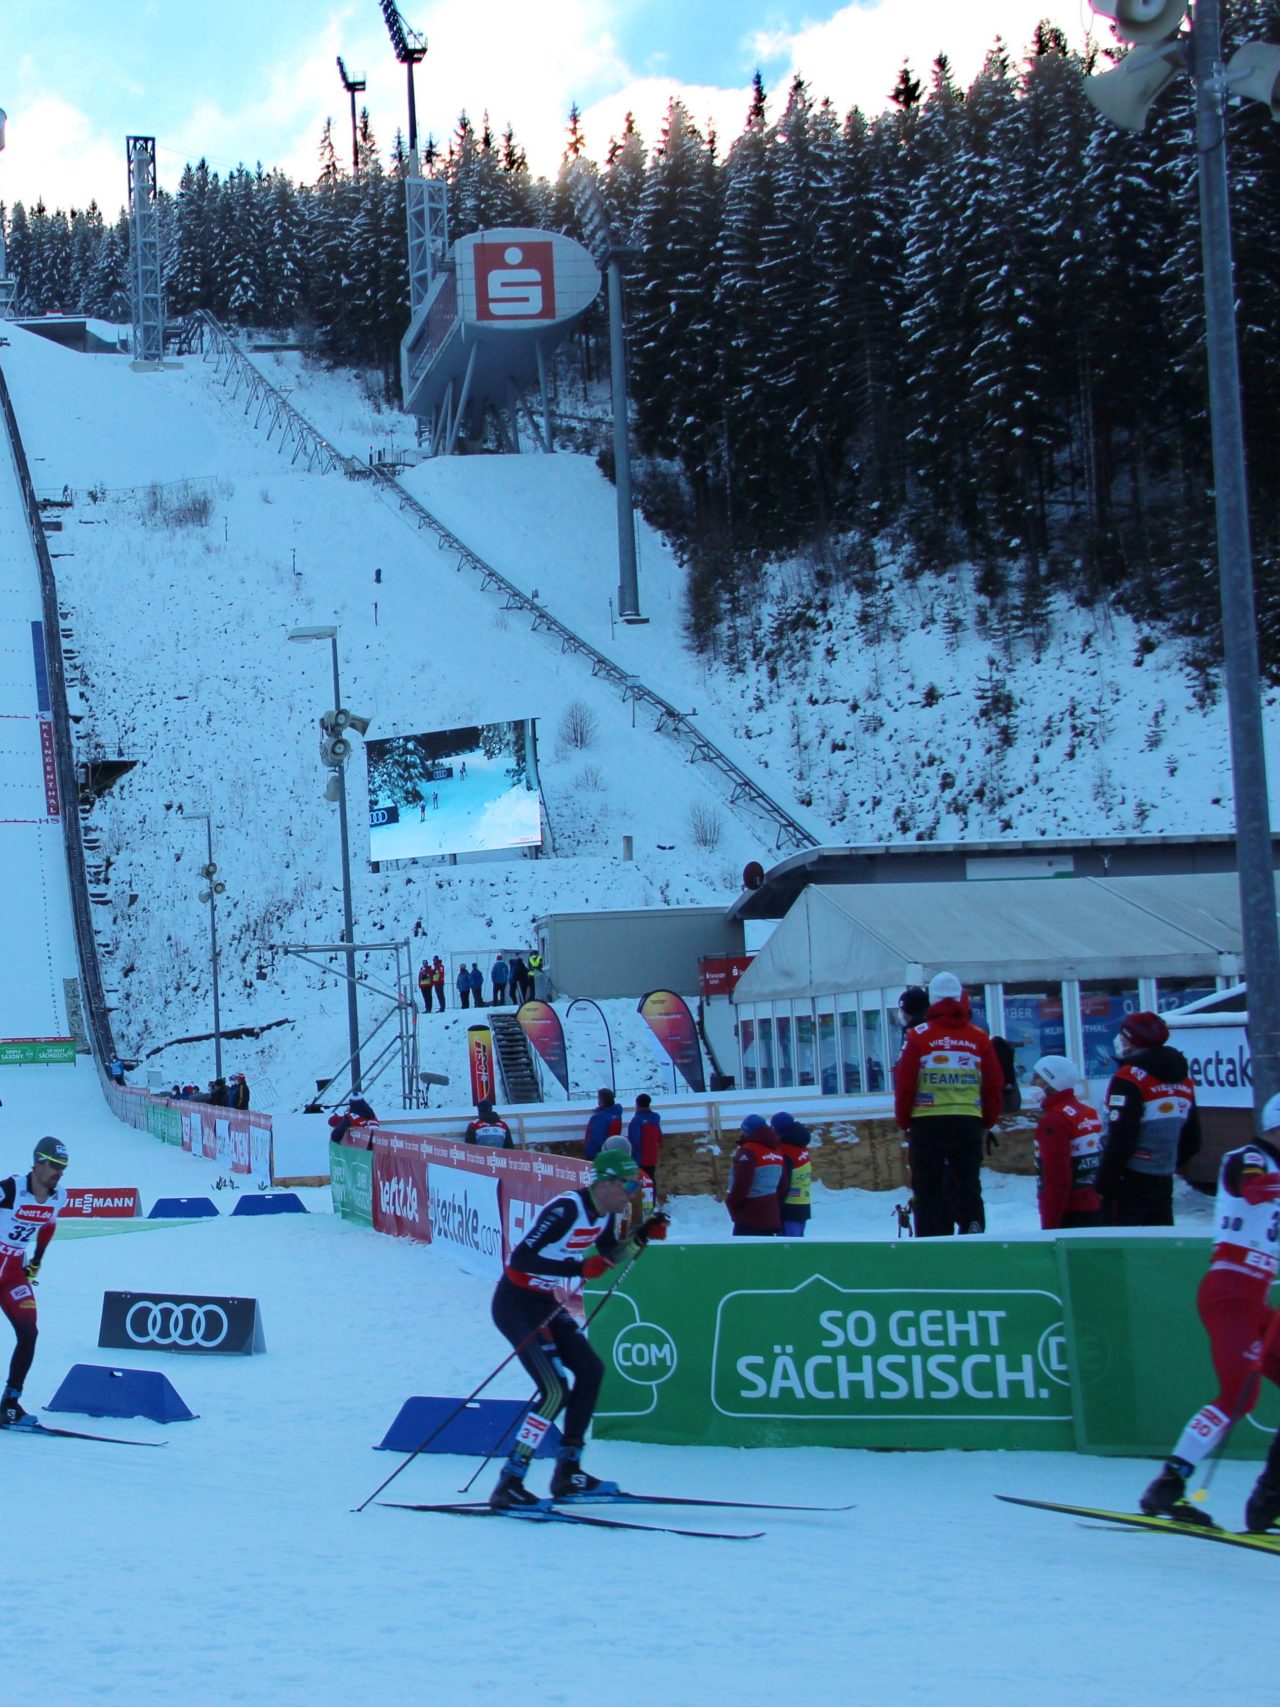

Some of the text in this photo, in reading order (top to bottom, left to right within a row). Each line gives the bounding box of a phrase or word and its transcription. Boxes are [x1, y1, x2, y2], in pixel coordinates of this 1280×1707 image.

[42, 724, 57, 813] KLINGENTHAL
[923, 1073, 959, 1085] TEAM
[8, 1225, 36, 1242] 32
[525, 1220, 551, 1248] Audi
[820, 1310, 1006, 1347] SO GEHT
[617, 1343, 672, 1366] COM
[736, 1345, 1049, 1399] SÄCHSISCH.
[521, 1427, 539, 1443] 31
[1191, 1419, 1211, 1437] 30
